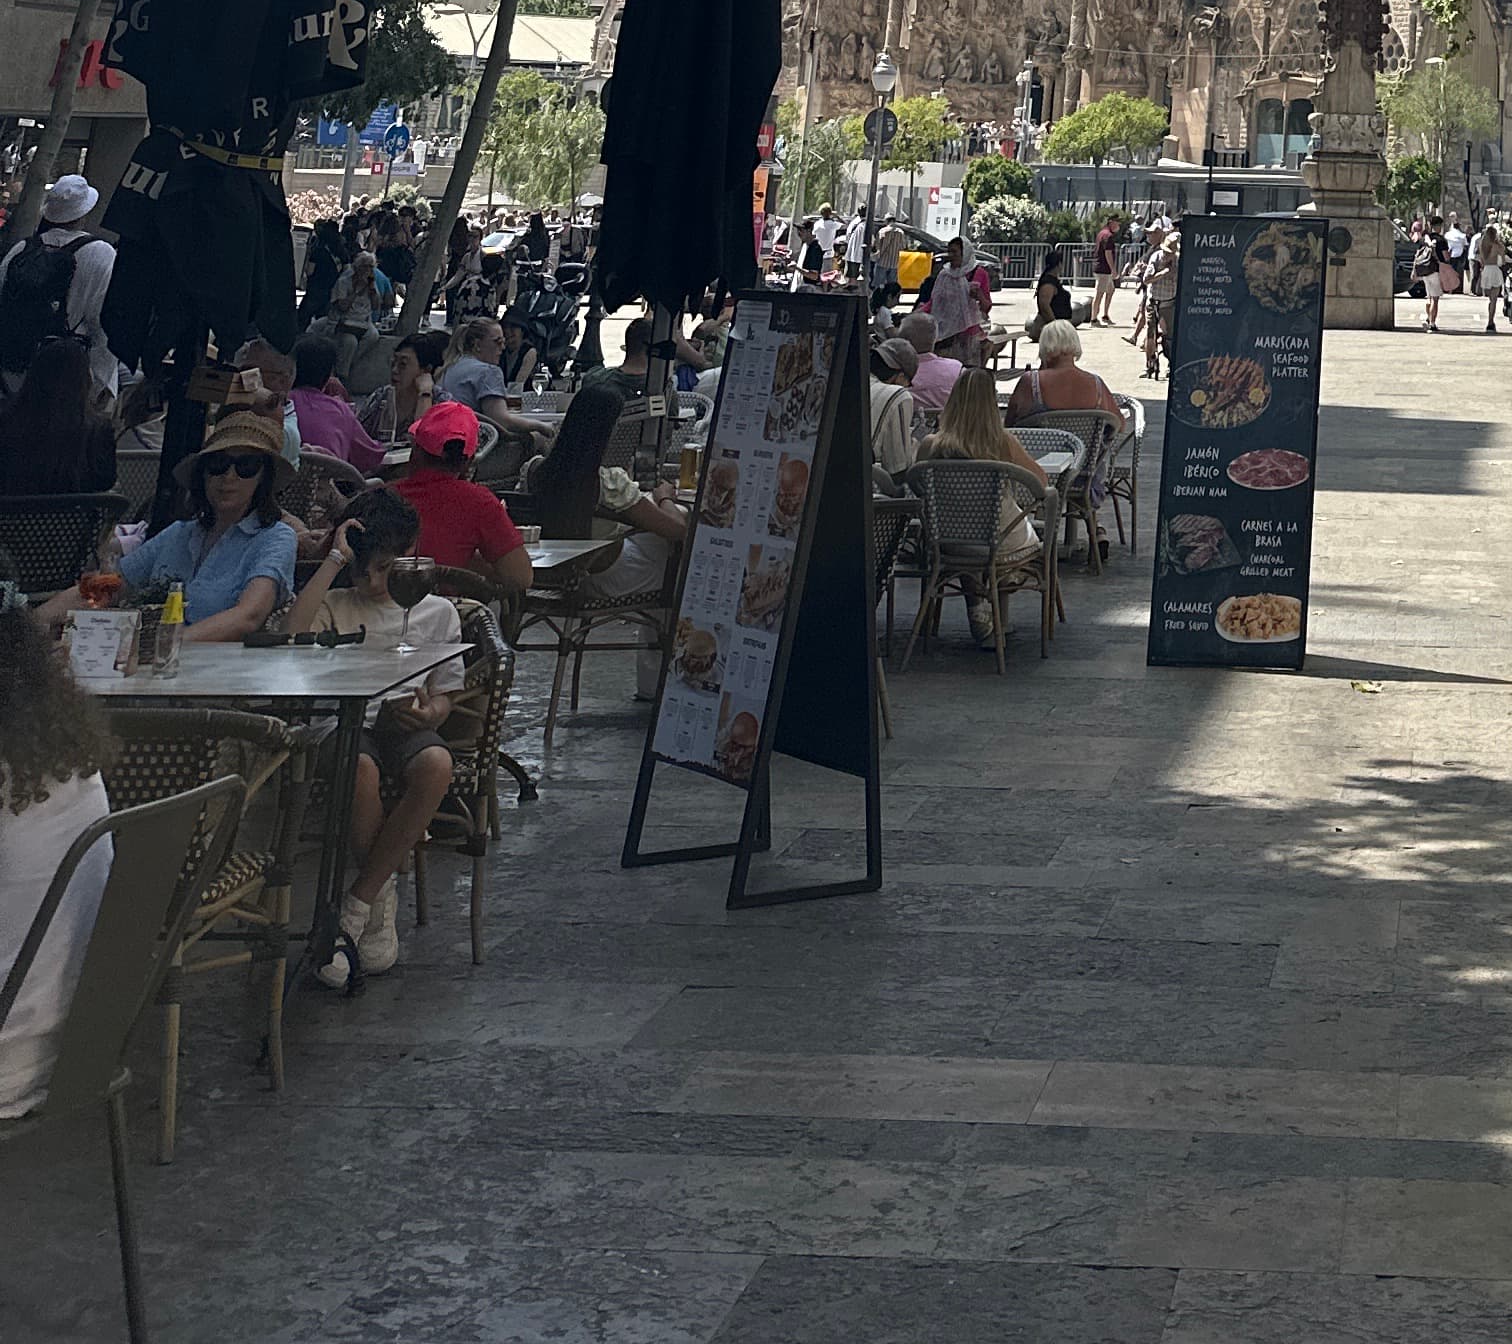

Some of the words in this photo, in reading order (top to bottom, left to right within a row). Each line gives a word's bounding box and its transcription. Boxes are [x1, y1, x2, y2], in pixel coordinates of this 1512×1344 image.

[1194, 233, 1236, 248] PAELLA
[1254, 335, 1310, 351] MARISCADA
[1272, 352, 1310, 366] SEAFOOD
[1271, 366, 1310, 379] PLATTER
[1185, 445, 1220, 461] JAMÓN
[1183, 463, 1220, 480] IBÉRICO
[1172, 484, 1206, 497] IBERIAN
[1240, 519, 1273, 533] CARNES
[1276, 521, 1283, 533] A
[1286, 521, 1298, 534] LA
[1255, 534, 1282, 548] BRASA
[1250, 553, 1285, 566] CHARCOAL
[1239, 565, 1270, 578] GRILLED
[1272, 567, 1296, 578] MEAT
[1163, 600, 1214, 616] CALAMARES
